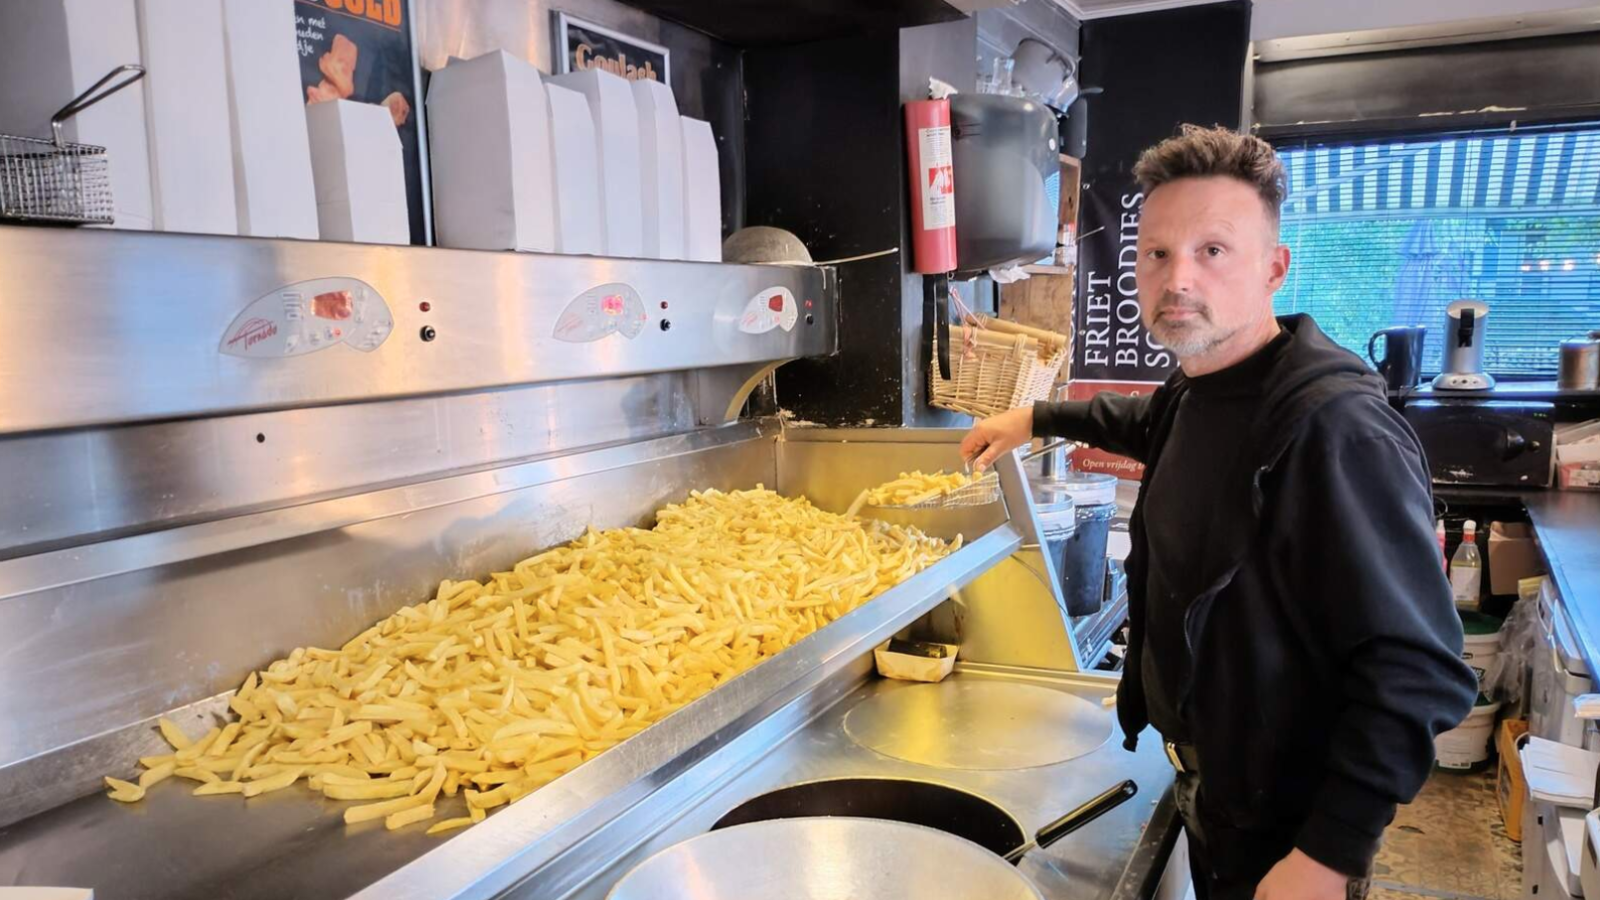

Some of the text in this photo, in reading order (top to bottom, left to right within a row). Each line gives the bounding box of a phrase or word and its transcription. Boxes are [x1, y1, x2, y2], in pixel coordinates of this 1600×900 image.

[1085, 271, 1111, 366] FRIET
[1115, 191, 1144, 367] BROODIES
[1082, 458, 1105, 470] Open
[1106, 460, 1137, 472] vrijdag
